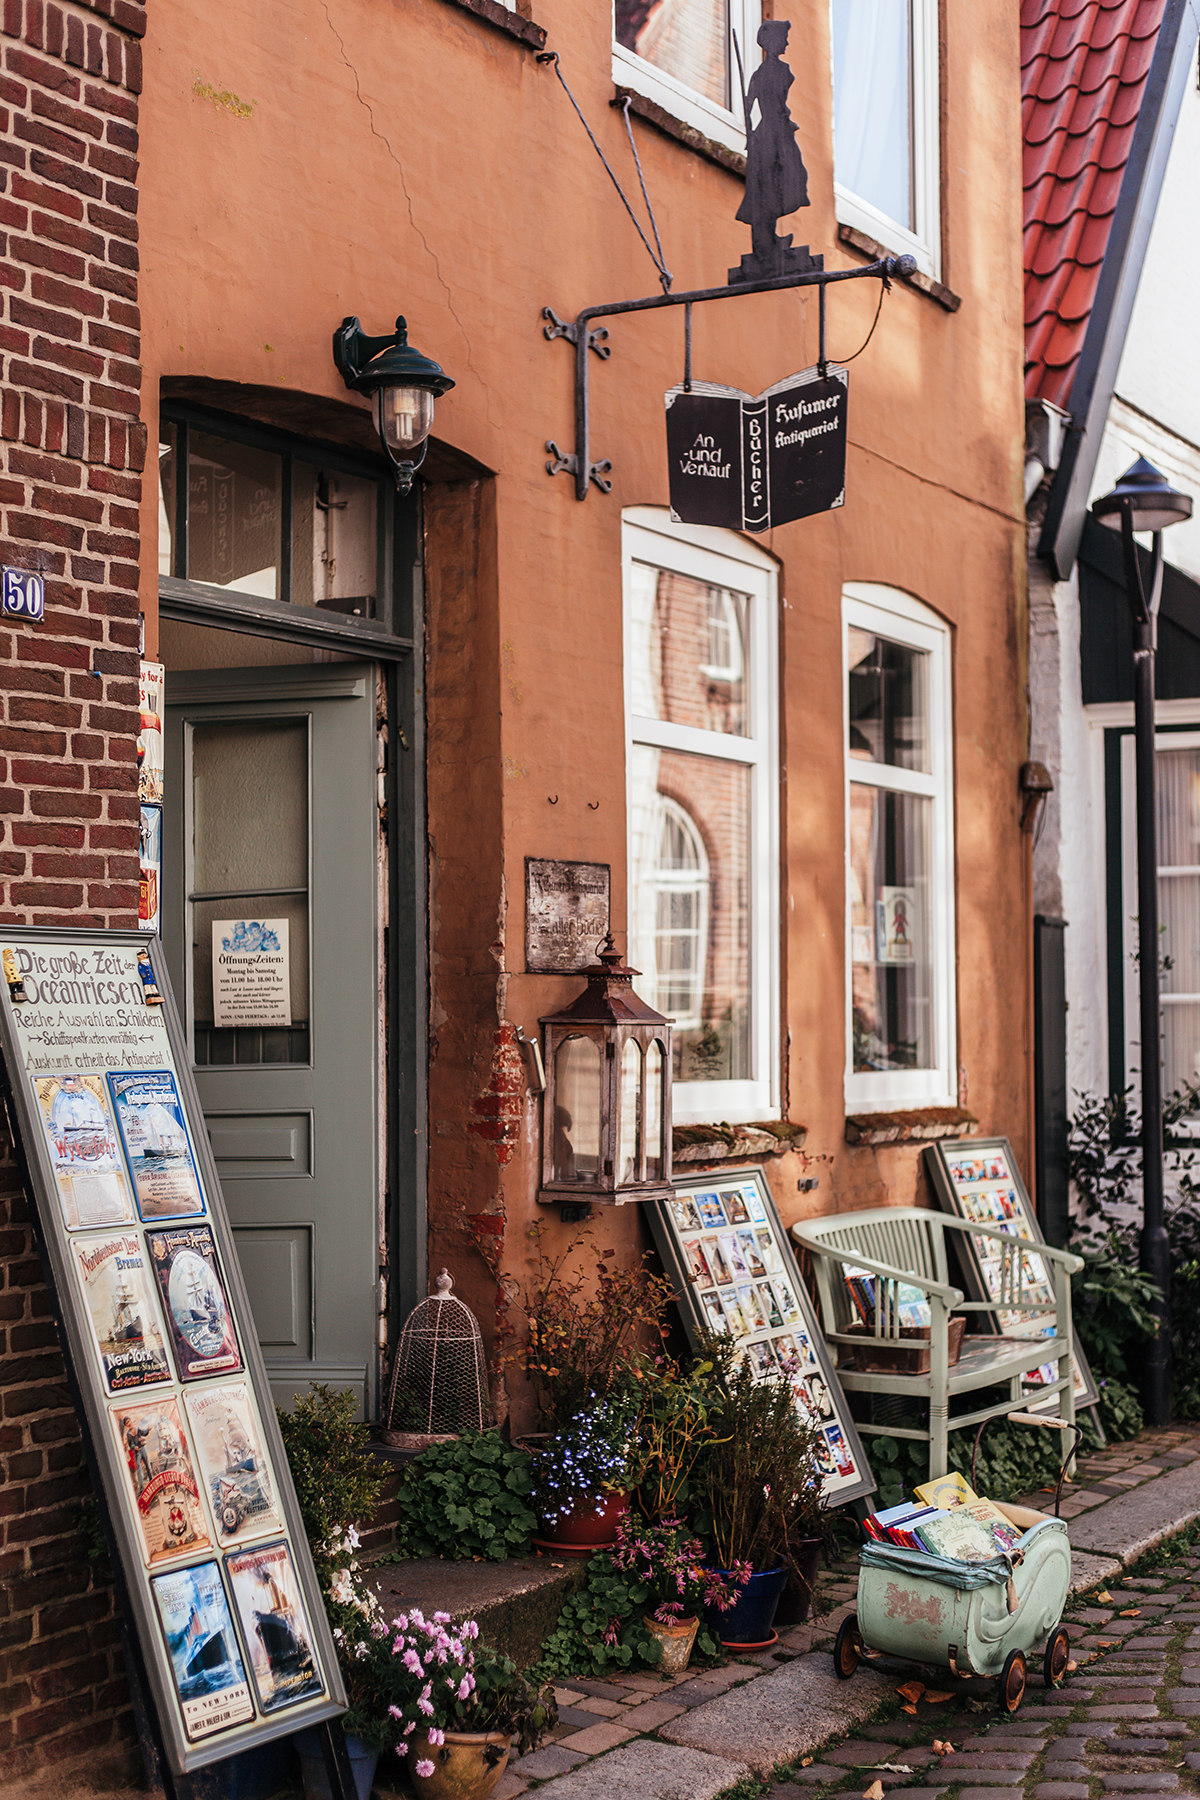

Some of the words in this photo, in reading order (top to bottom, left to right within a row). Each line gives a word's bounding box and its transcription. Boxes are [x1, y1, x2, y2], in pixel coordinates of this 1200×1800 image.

[775, 394, 841, 423] Husumer
[693, 433, 715, 448] An
[775, 415, 840, 448] Antiquariat
[679, 460, 731, 479] Verkauf
[749, 418, 762, 507] Bücher
[8, 573, 40, 615] 50
[147, 670, 157, 681] for
[14, 946, 48, 974] Die
[49, 951, 91, 980] große
[92, 950, 124, 976] Zeit
[124, 959, 135, 971] der
[255, 967, 277, 975] Samstag
[22, 974, 145, 1005] Oceanriesen
[12, 1008, 55, 1029] Reiche
[57, 1010, 103, 1028] Auswahl
[105, 1015, 118, 1027] an
[25, 1050, 73, 1070] Auskunft
[105, 1052, 120, 1066] das
[121, 1049, 164, 1069] Antiquariat
[114, 1256, 144, 1271] Bremen
[156, 1580, 183, 1594] WHITE
[198, 1581, 222, 1594] TITANIC
[162, 1591, 185, 1605] STAR
[166, 1602, 187, 1615] LINE
[280, 1670, 313, 1688] IMPERATOR
[186, 1705, 197, 1714] To
[202, 1698, 220, 1709] NEW
